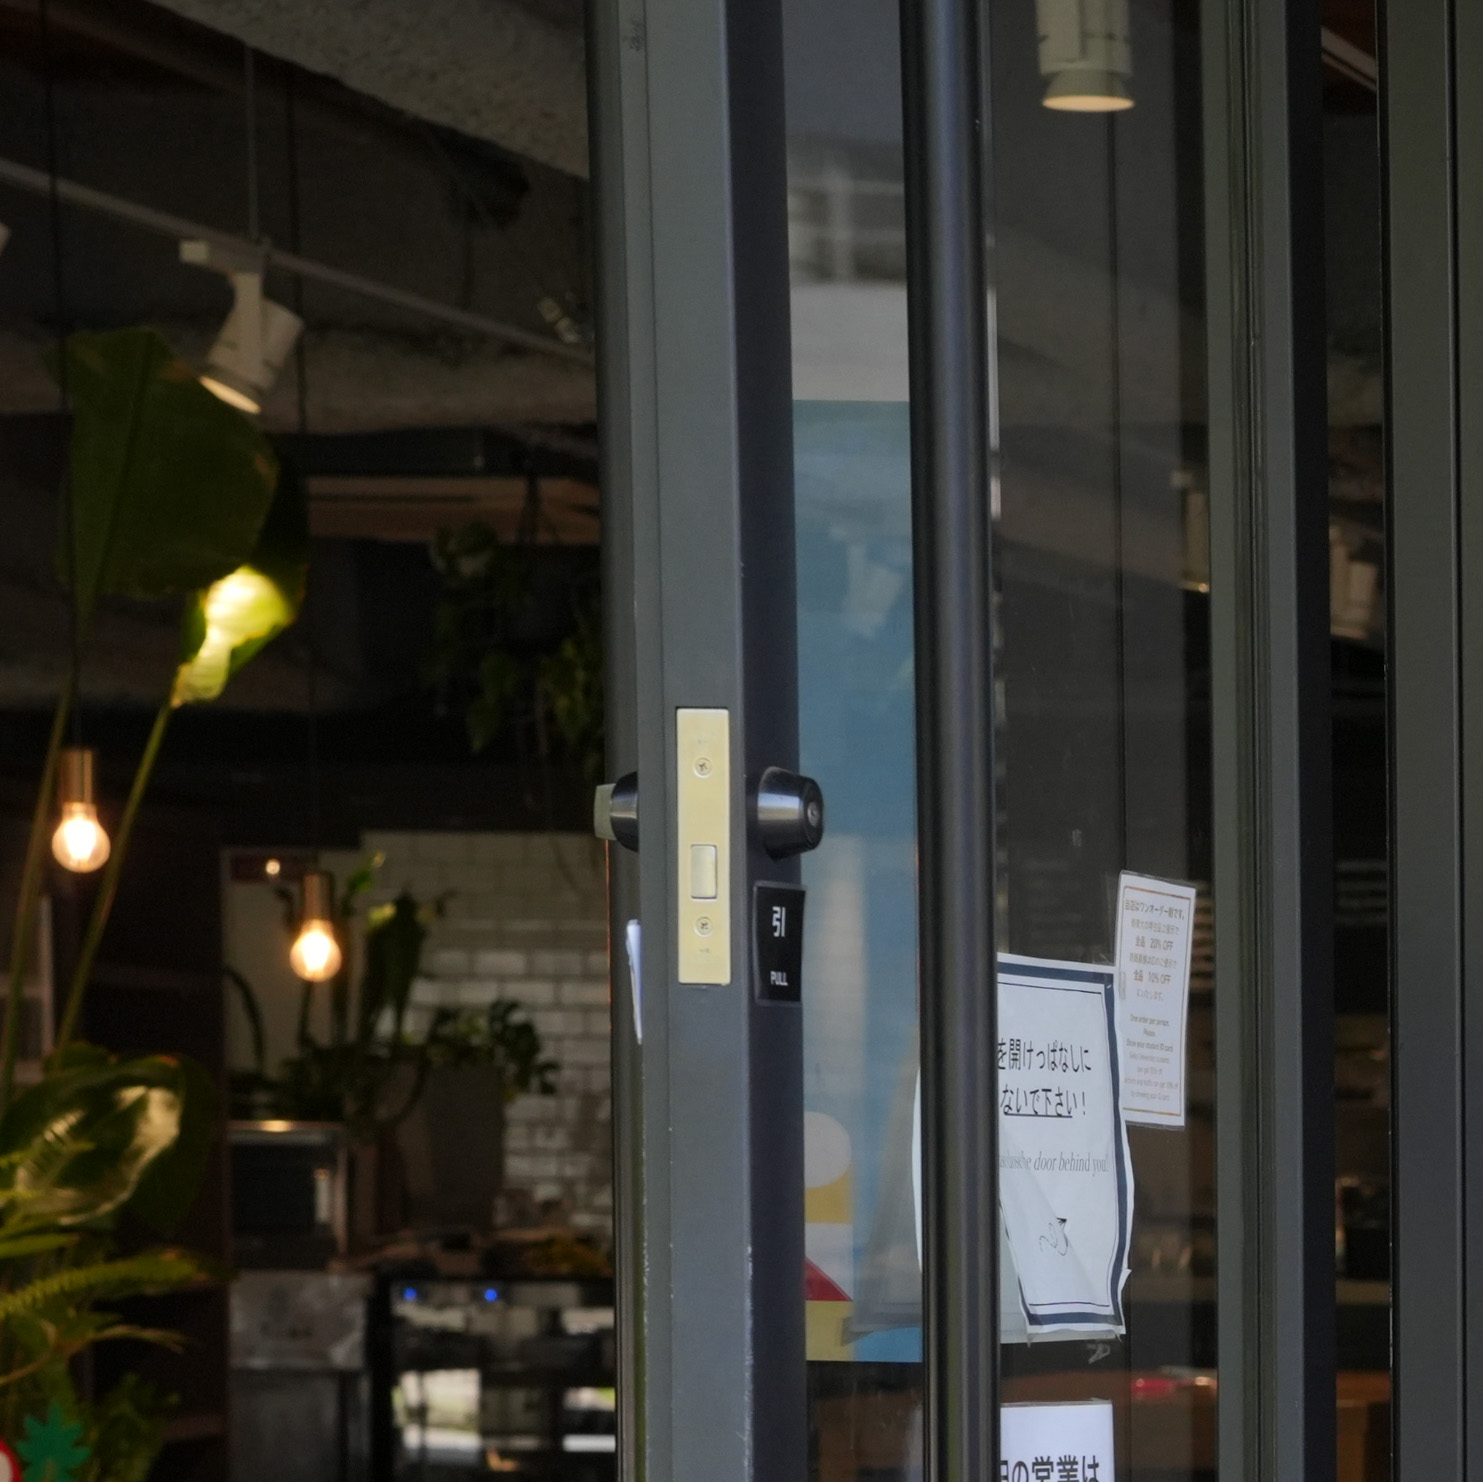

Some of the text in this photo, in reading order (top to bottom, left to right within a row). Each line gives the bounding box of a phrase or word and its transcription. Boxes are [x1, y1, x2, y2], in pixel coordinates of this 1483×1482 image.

[770, 970, 788, 986] PULL
[1033, 1151, 1057, 1171] door
[1058, 1152, 1092, 1173] behind
